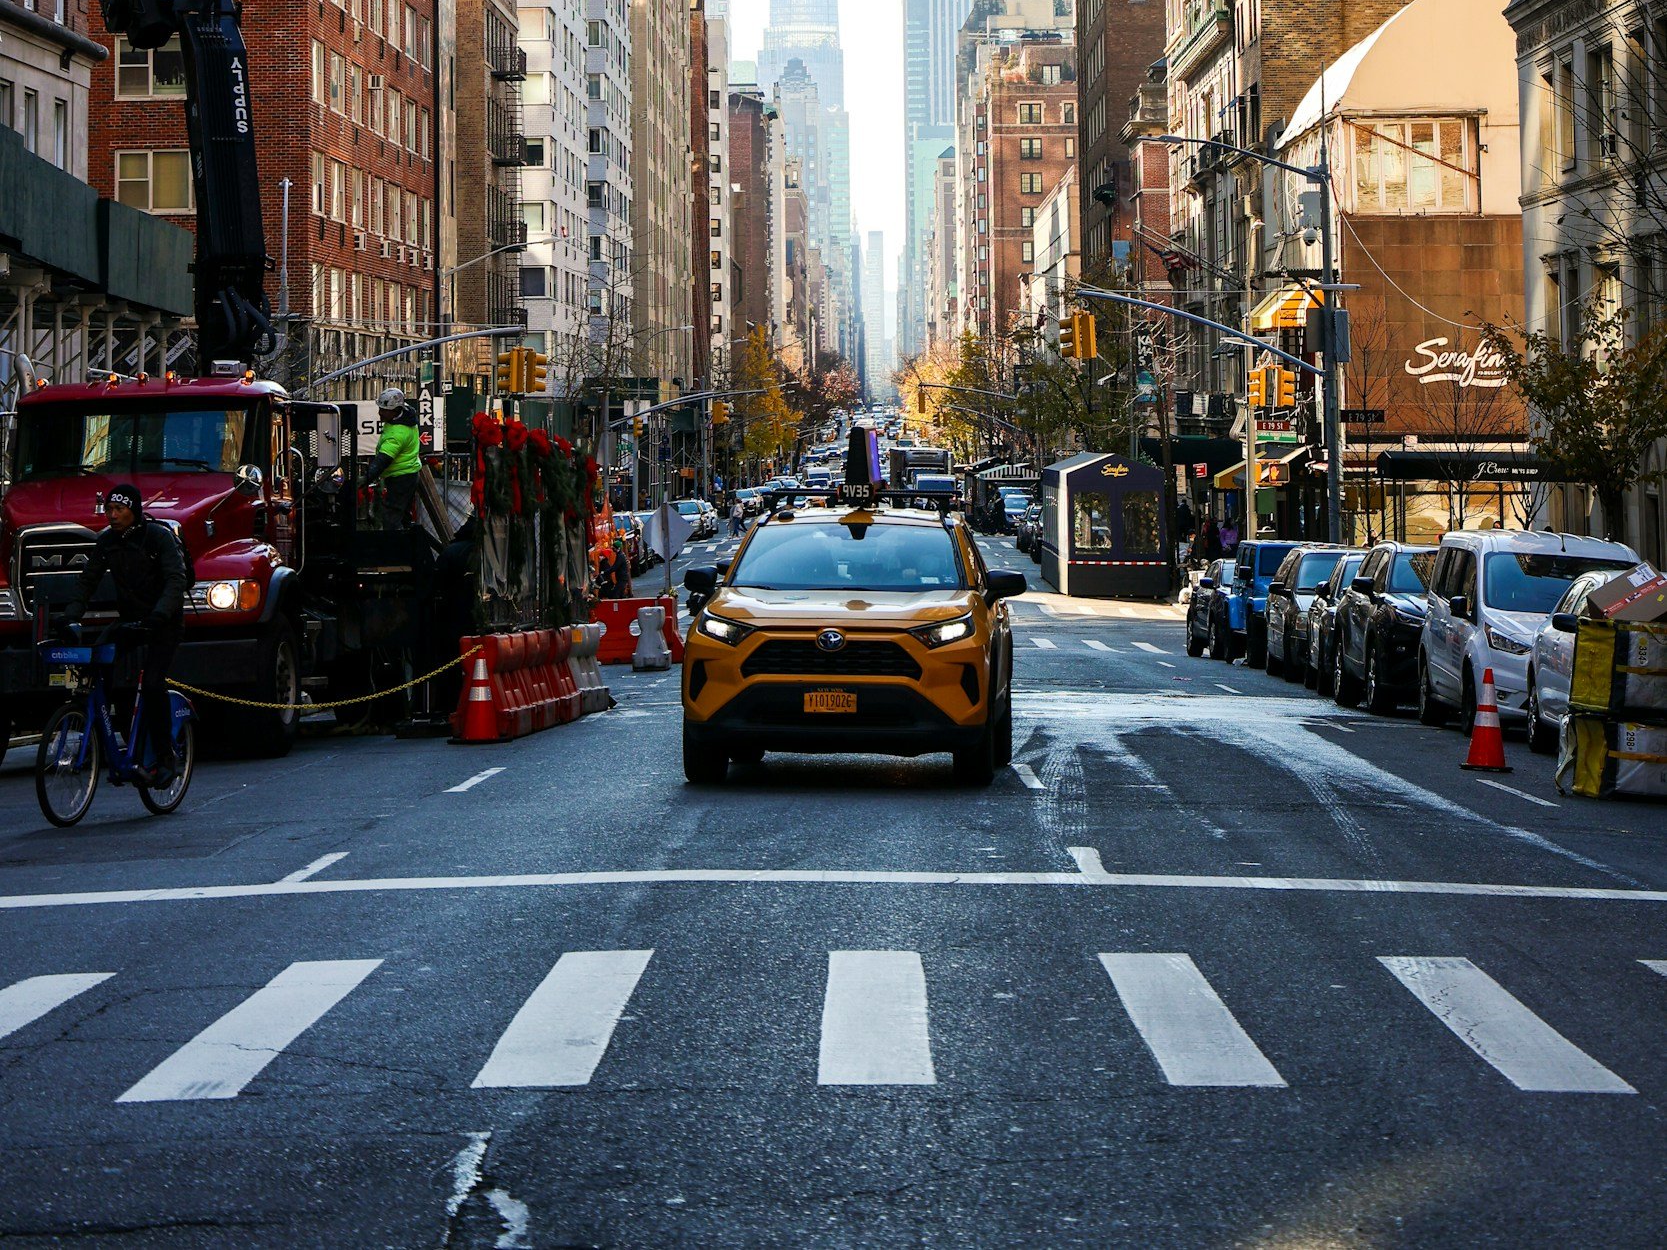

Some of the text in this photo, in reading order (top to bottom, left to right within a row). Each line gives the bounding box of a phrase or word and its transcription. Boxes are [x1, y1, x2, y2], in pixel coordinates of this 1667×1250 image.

[231, 57, 248, 133] SUPPLY
[1404, 337, 1507, 387] Serafin
[1268, 422, 1275, 430] 79
[1277, 422, 1283, 430] St
[842, 484, 870, 498] 9V35
[110, 493, 133, 508] 2021
[32, 553, 90, 567] MA
[809, 694, 852, 708] Y101902C
[1626, 731, 1635, 747] 298
